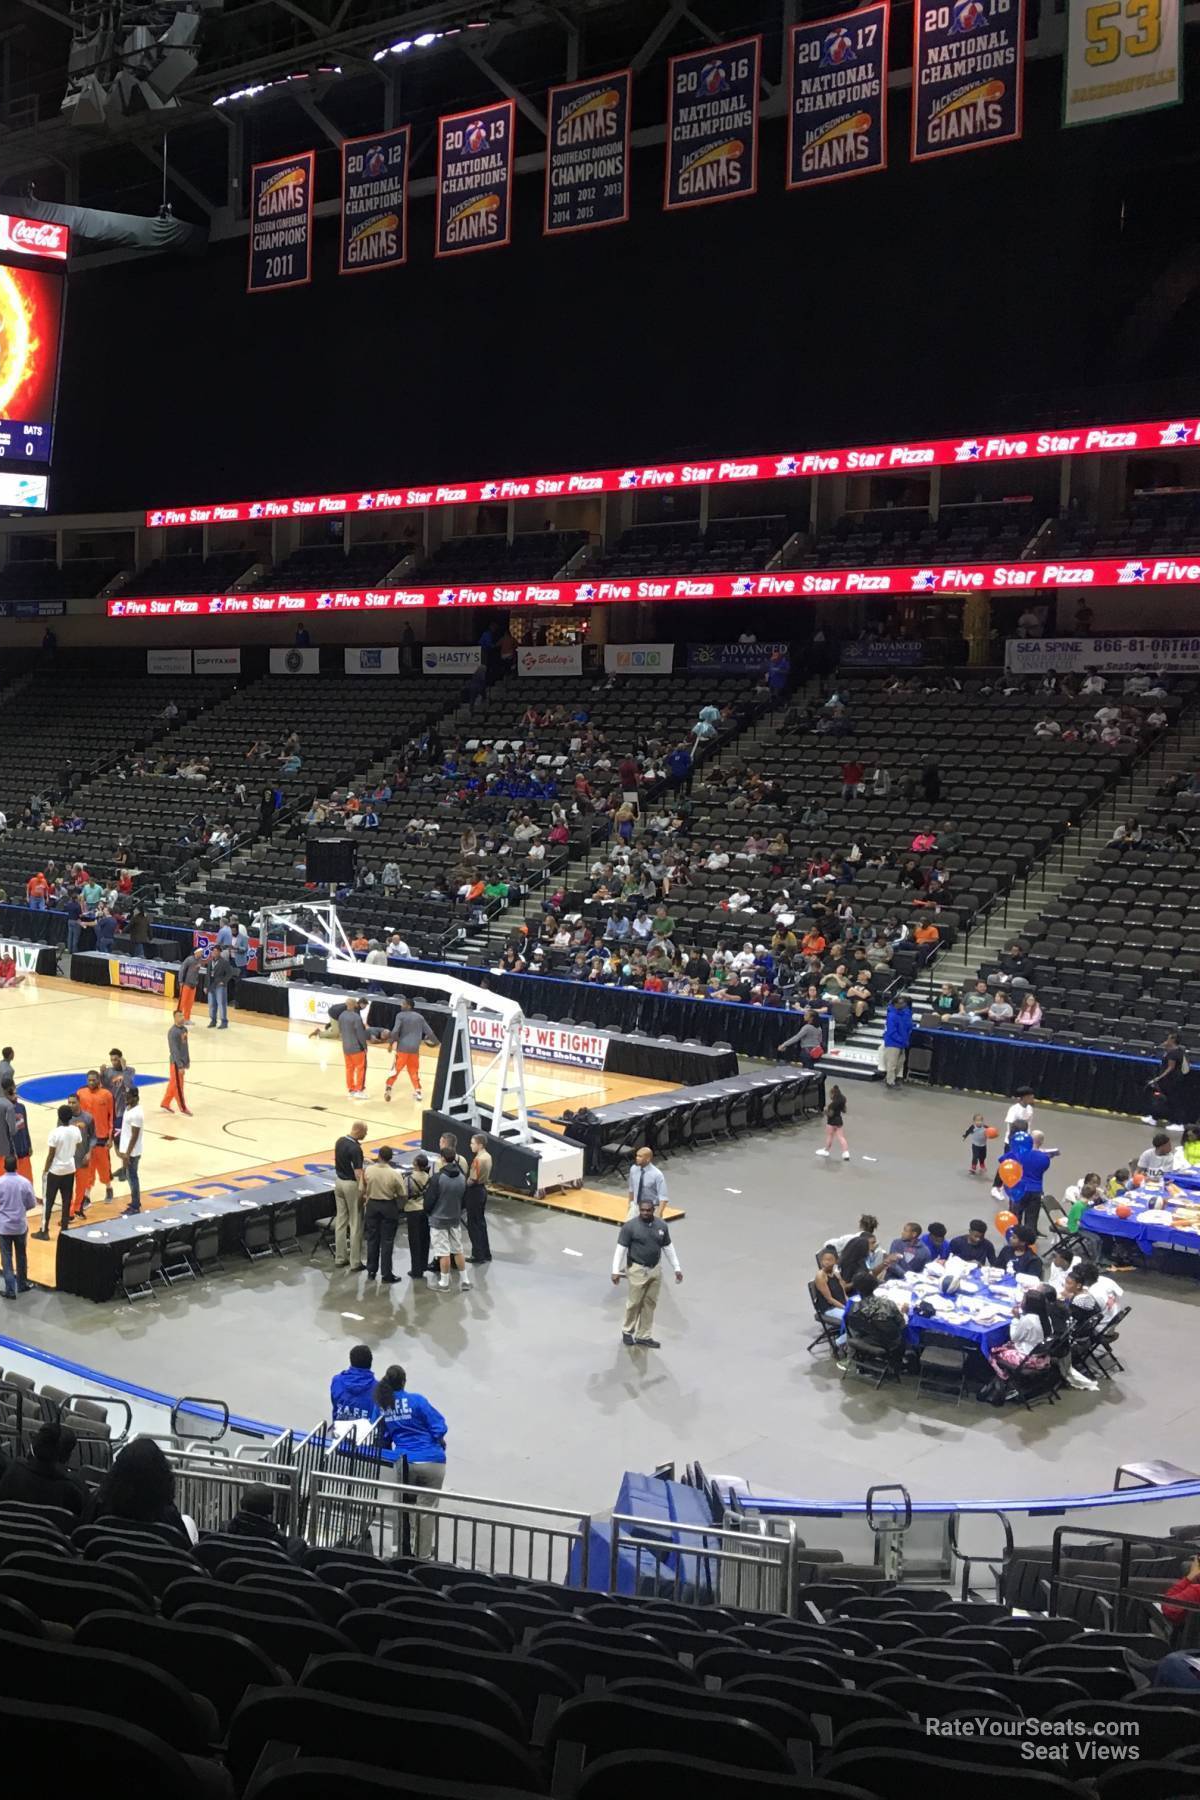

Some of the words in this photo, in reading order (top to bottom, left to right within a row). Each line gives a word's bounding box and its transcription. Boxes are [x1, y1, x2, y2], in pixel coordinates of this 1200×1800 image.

[924, 6, 950, 33] 20
[798, 41, 821, 64] 20
[856, 24, 878, 50] 17
[1084, 0, 1162, 67] 53
[927, 28, 1009, 66] NATIONAL
[676, 71, 698, 94] 20
[729, 57, 749, 81] 16
[800, 63, 875, 95] NATIONAL
[921, 47, 1016, 86] CHAMPIONS
[679, 94, 747, 124] NATIONAL
[795, 80, 880, 115] CHAMPIONS
[556, 108, 617, 147] GIANTS
[673, 110, 752, 142] CHAMPIONS
[927, 98, 1003, 145] GIANTS
[445, 131, 463, 151] 20
[490, 120, 505, 141] 13
[348, 154, 364, 173] 20
[388, 145, 401, 164] 12
[552, 149, 592, 167] SOUTHEAST
[592, 140, 623, 159] DIVISION
[801, 130, 869, 173] GIANTS
[447, 152, 503, 178] NATIONAL
[551, 156, 624, 187] CHAMPIONS
[678, 155, 742, 195] GIANTS
[350, 176, 401, 199] NATIONAL
[443, 167, 507, 194] CHAMPIONS
[258, 187, 304, 217] GIANTS
[346, 190, 402, 215] CHAMPIONS
[553, 191, 570, 206] 2011
[577, 187, 596, 201] 2012
[604, 182, 622, 197] 2013
[254, 220, 275, 234] EASTERN
[446, 209, 498, 243] GIANTS
[552, 209, 571, 224] 2014
[576, 205, 594, 220] 2015
[12, 220, 62, 248] Coca-Cola
[254, 226, 306, 251] CHAMPIONS
[348, 231, 397, 263] GIANTS
[265, 254, 293, 279] 2011
[23, 425, 43, 436] BATS
[0, 447, 5, 457] 0
[26, 442, 33, 456] 0
[985, 439, 1028, 457] Five
[1036, 435, 1080, 453] Star
[1085, 430, 1138, 450] Pizza
[802, 455, 840, 472] Five
[846, 451, 884, 469] Star
[889, 448, 935, 465] Pizza
[501, 482, 530, 497] Five
[534, 479, 564, 494] Star
[568, 476, 604, 491] Pizza
[641, 469, 675, 485] Five
[680, 466, 714, 482] Star
[718, 463, 759, 479] Pizza
[265, 502, 288, 516] Five
[292, 500, 316, 514] Star
[318, 498, 347, 512] Pizza
[375, 493, 402, 507] Five
[406, 490, 433, 505] Star
[435, 488, 467, 502] Pizza
[165, 511, 186, 523] Five
[190, 509, 211, 522] Star
[213, 507, 239, 520] Pizza
[757, 577, 795, 594] Five
[802, 575, 841, 592] Star
[845, 573, 891, 590] Pizza
[941, 570, 985, 588] Five
[993, 568, 1037, 586] Star
[1042, 565, 1095, 584] Pizza
[1152, 562, 1200, 580] Five
[335, 593, 361, 607] Five
[365, 592, 392, 606] Star
[394, 592, 425, 606] Pizza
[458, 589, 487, 604] Five
[492, 587, 522, 602] Star
[525, 586, 561, 601] Pizza
[598, 583, 632, 599] Five
[636, 582, 670, 598] Star
[675, 580, 714, 596] Pizza
[125, 601, 147, 614] Five
[150, 600, 171, 613] Star
[173, 599, 199, 612] Pizza
[224, 598, 248, 611] Five
[252, 597, 274, 610] Star
[277, 595, 305, 609] Pizza
[440, 652, 480, 663] HASTY'S
[722, 643, 788, 655] ADVANCED
[1017, 642, 1040, 653] SEA
[1045, 641, 1083, 652] SPINE
[1093, 639, 1200, 653] 866-81-ORTHO
[471, 1019, 487, 1036] OU
[537, 1029, 555, 1047] WE
[561, 1033, 603, 1056] FIGHT!
[477, 1037, 493, 1047] Law
[536, 1048, 551, 1057] Ron
